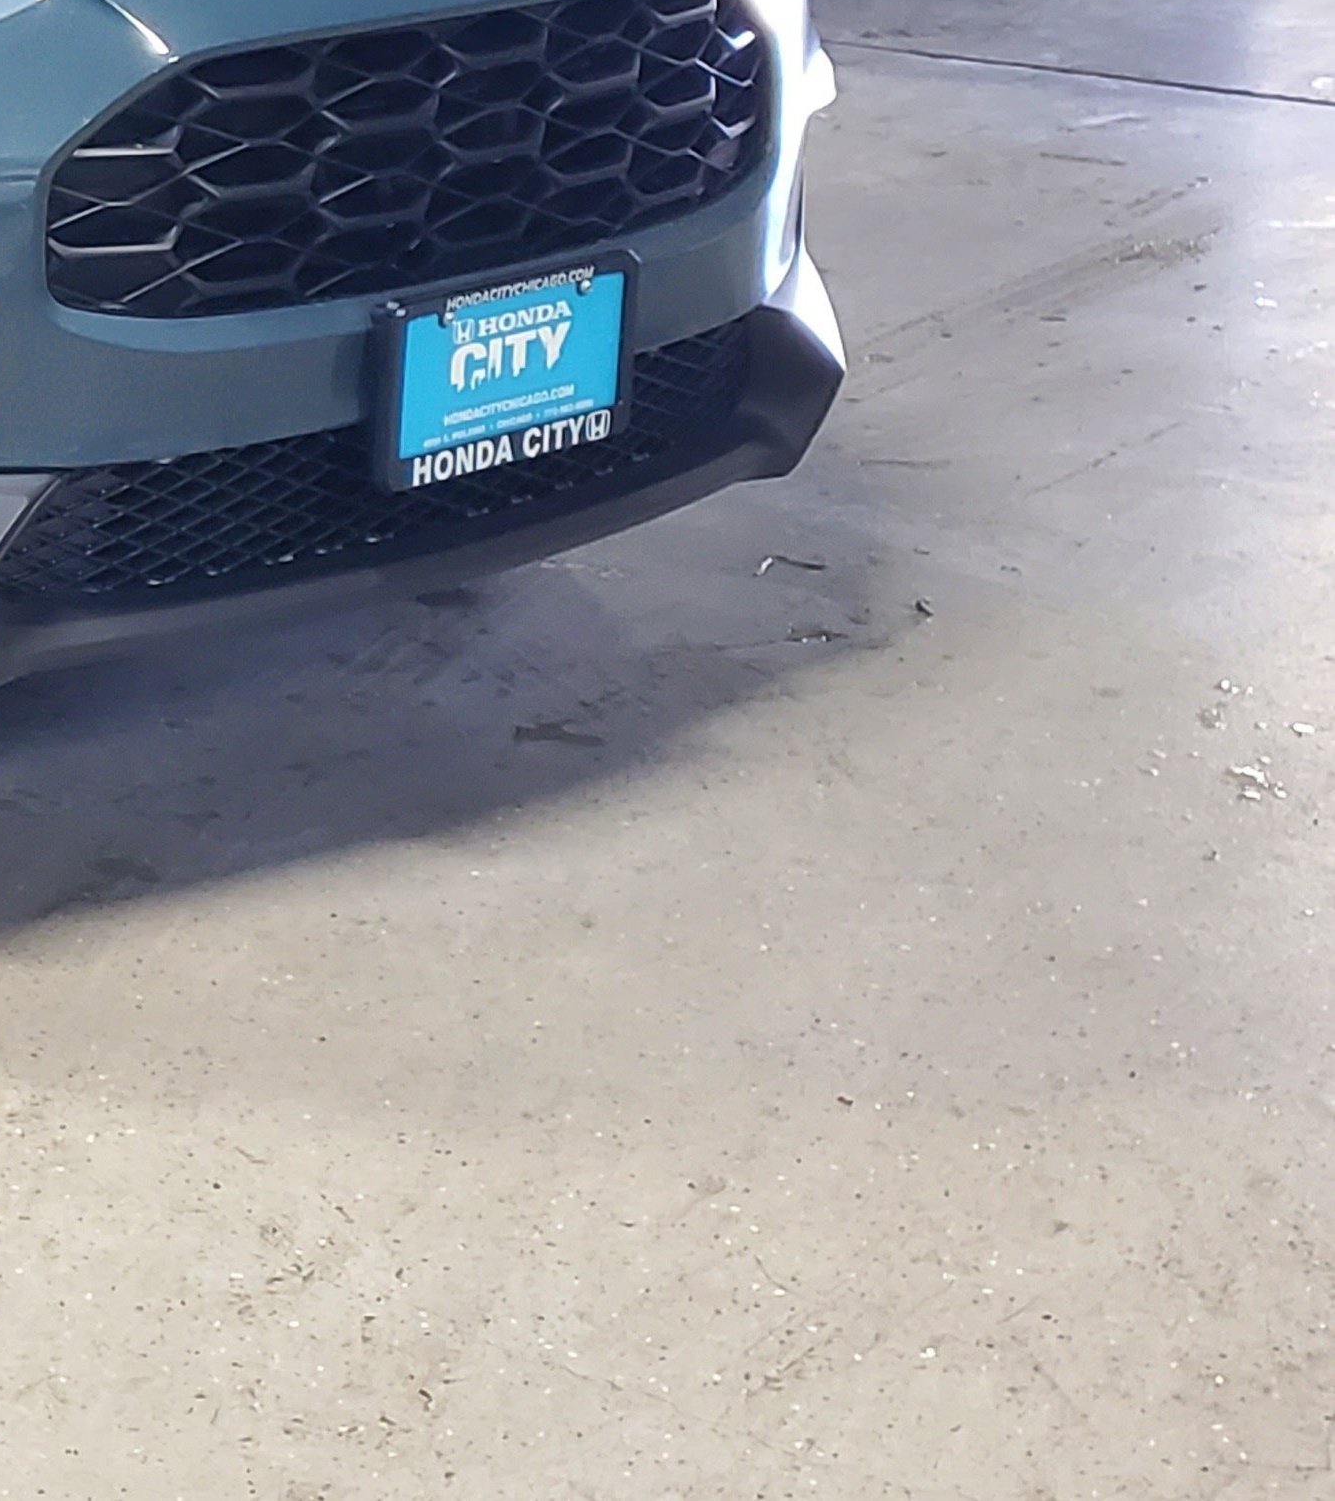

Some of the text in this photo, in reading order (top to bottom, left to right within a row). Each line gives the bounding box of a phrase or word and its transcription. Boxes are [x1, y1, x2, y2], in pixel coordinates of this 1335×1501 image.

[478, 300, 572, 337] HONDA
[450, 320, 572, 393] CITY
[412, 435, 514, 487] HONDA
[522, 414, 585, 459] CITY
